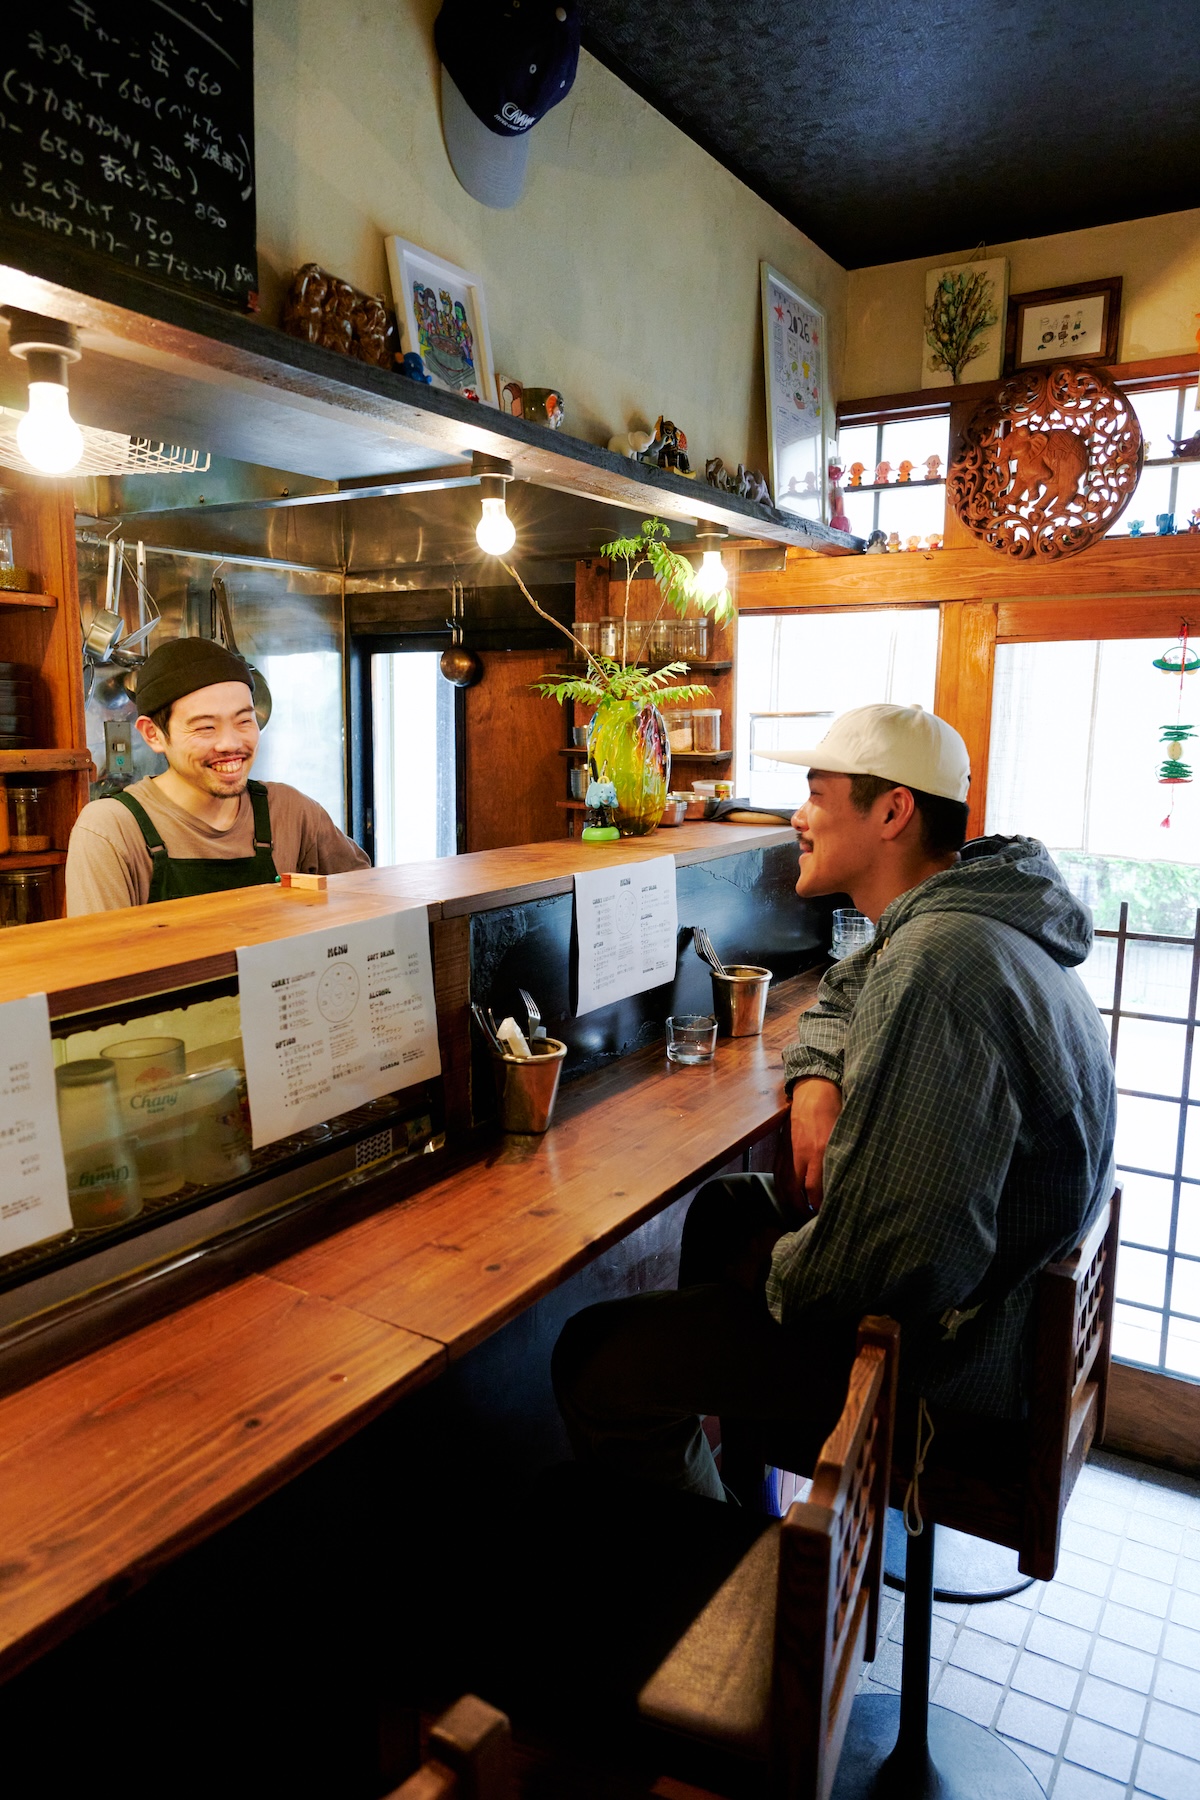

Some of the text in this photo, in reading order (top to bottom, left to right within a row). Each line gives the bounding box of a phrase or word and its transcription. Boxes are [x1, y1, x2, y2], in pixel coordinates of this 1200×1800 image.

[118, 78, 152, 109] 650
[184, 67, 222, 96] 660
[40, 128, 85, 166] 650
[129, 211, 174, 246] 750
[327, 943, 348, 958] MENU
[130, 1091, 178, 1110] Chang
